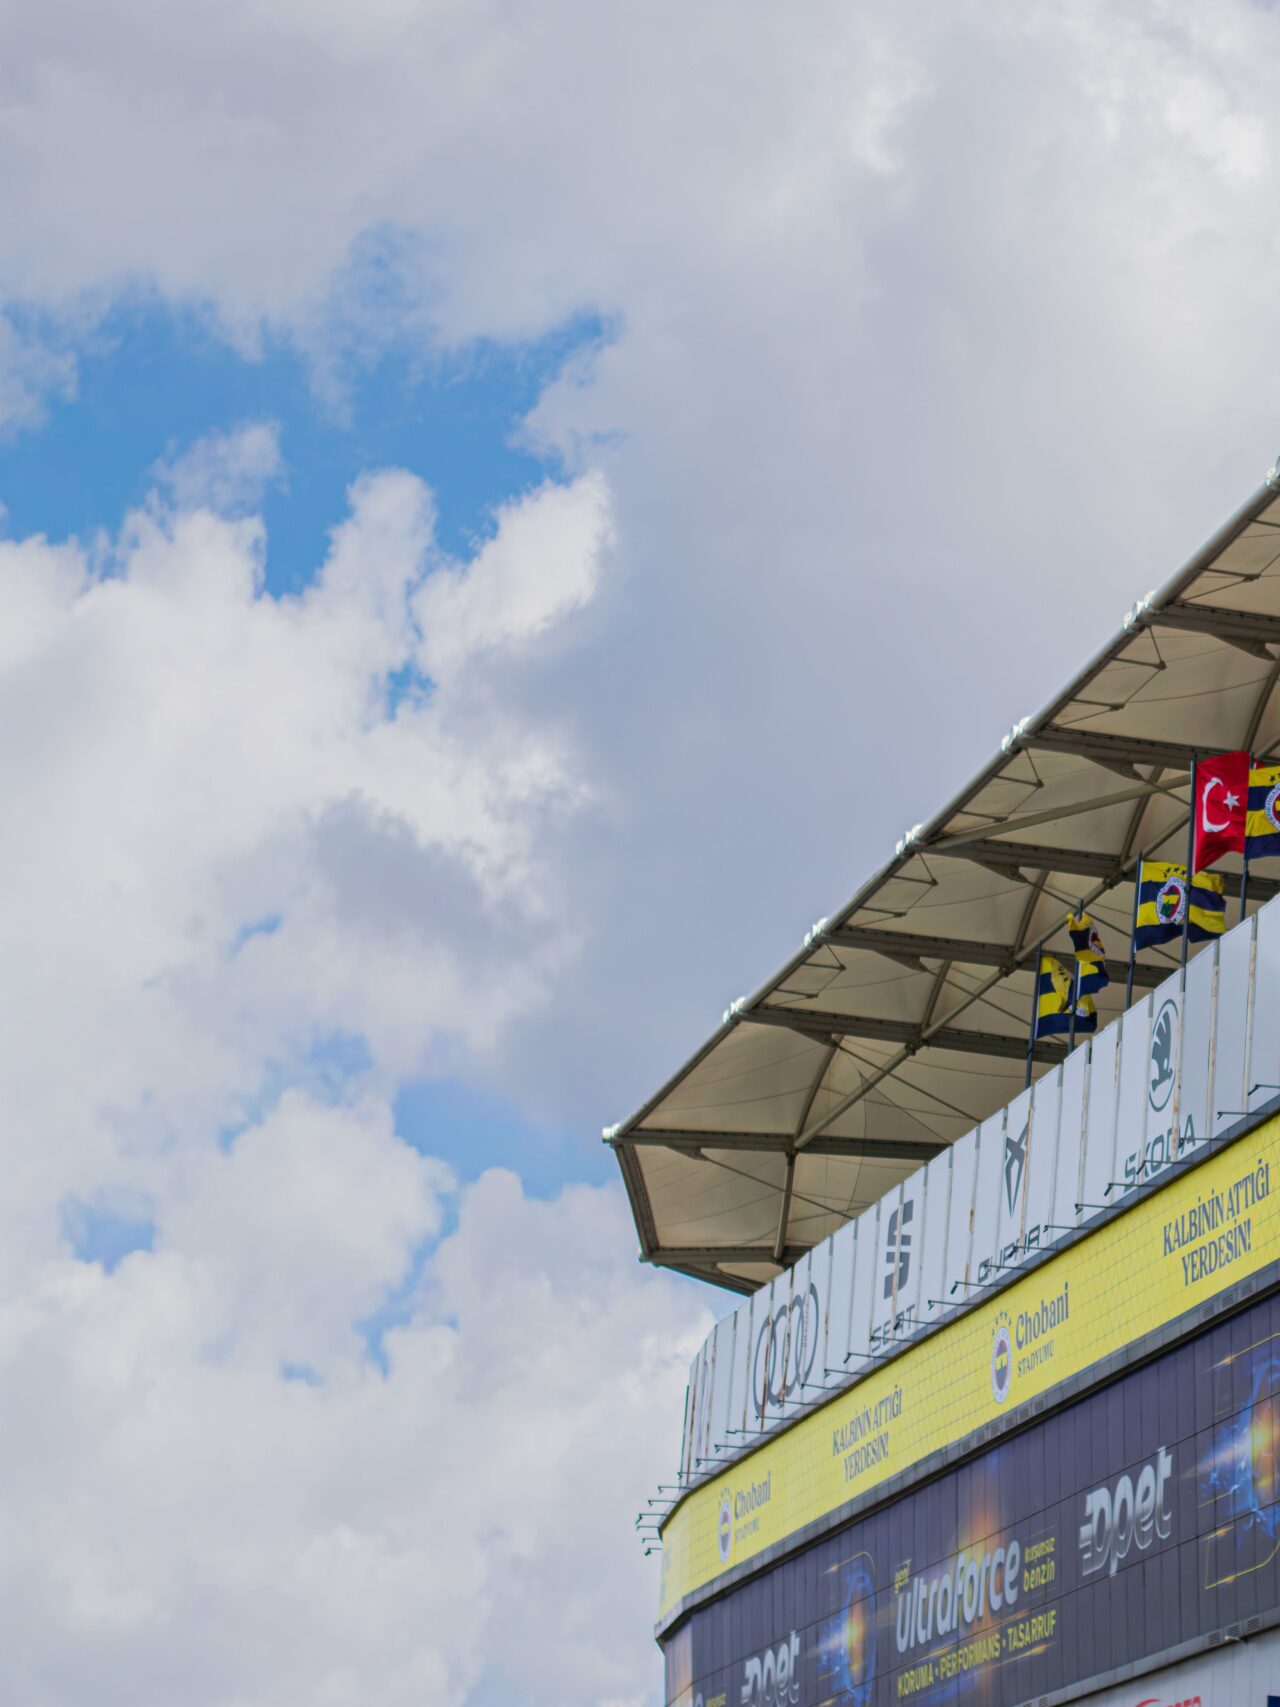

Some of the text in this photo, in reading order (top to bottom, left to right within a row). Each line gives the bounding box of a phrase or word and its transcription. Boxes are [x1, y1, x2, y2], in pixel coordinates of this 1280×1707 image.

[1163, 1158, 1270, 1257] KALBİNİN ATTIĞI
[1181, 1217, 1251, 1287] YERDESİN!
[1016, 1281, 1069, 1350] Chobani
[1023, 1558, 1055, 1593] benzin
[897, 1662, 934, 1698] KORUMA
[1007, 1609, 1057, 1652] TASARRUF
